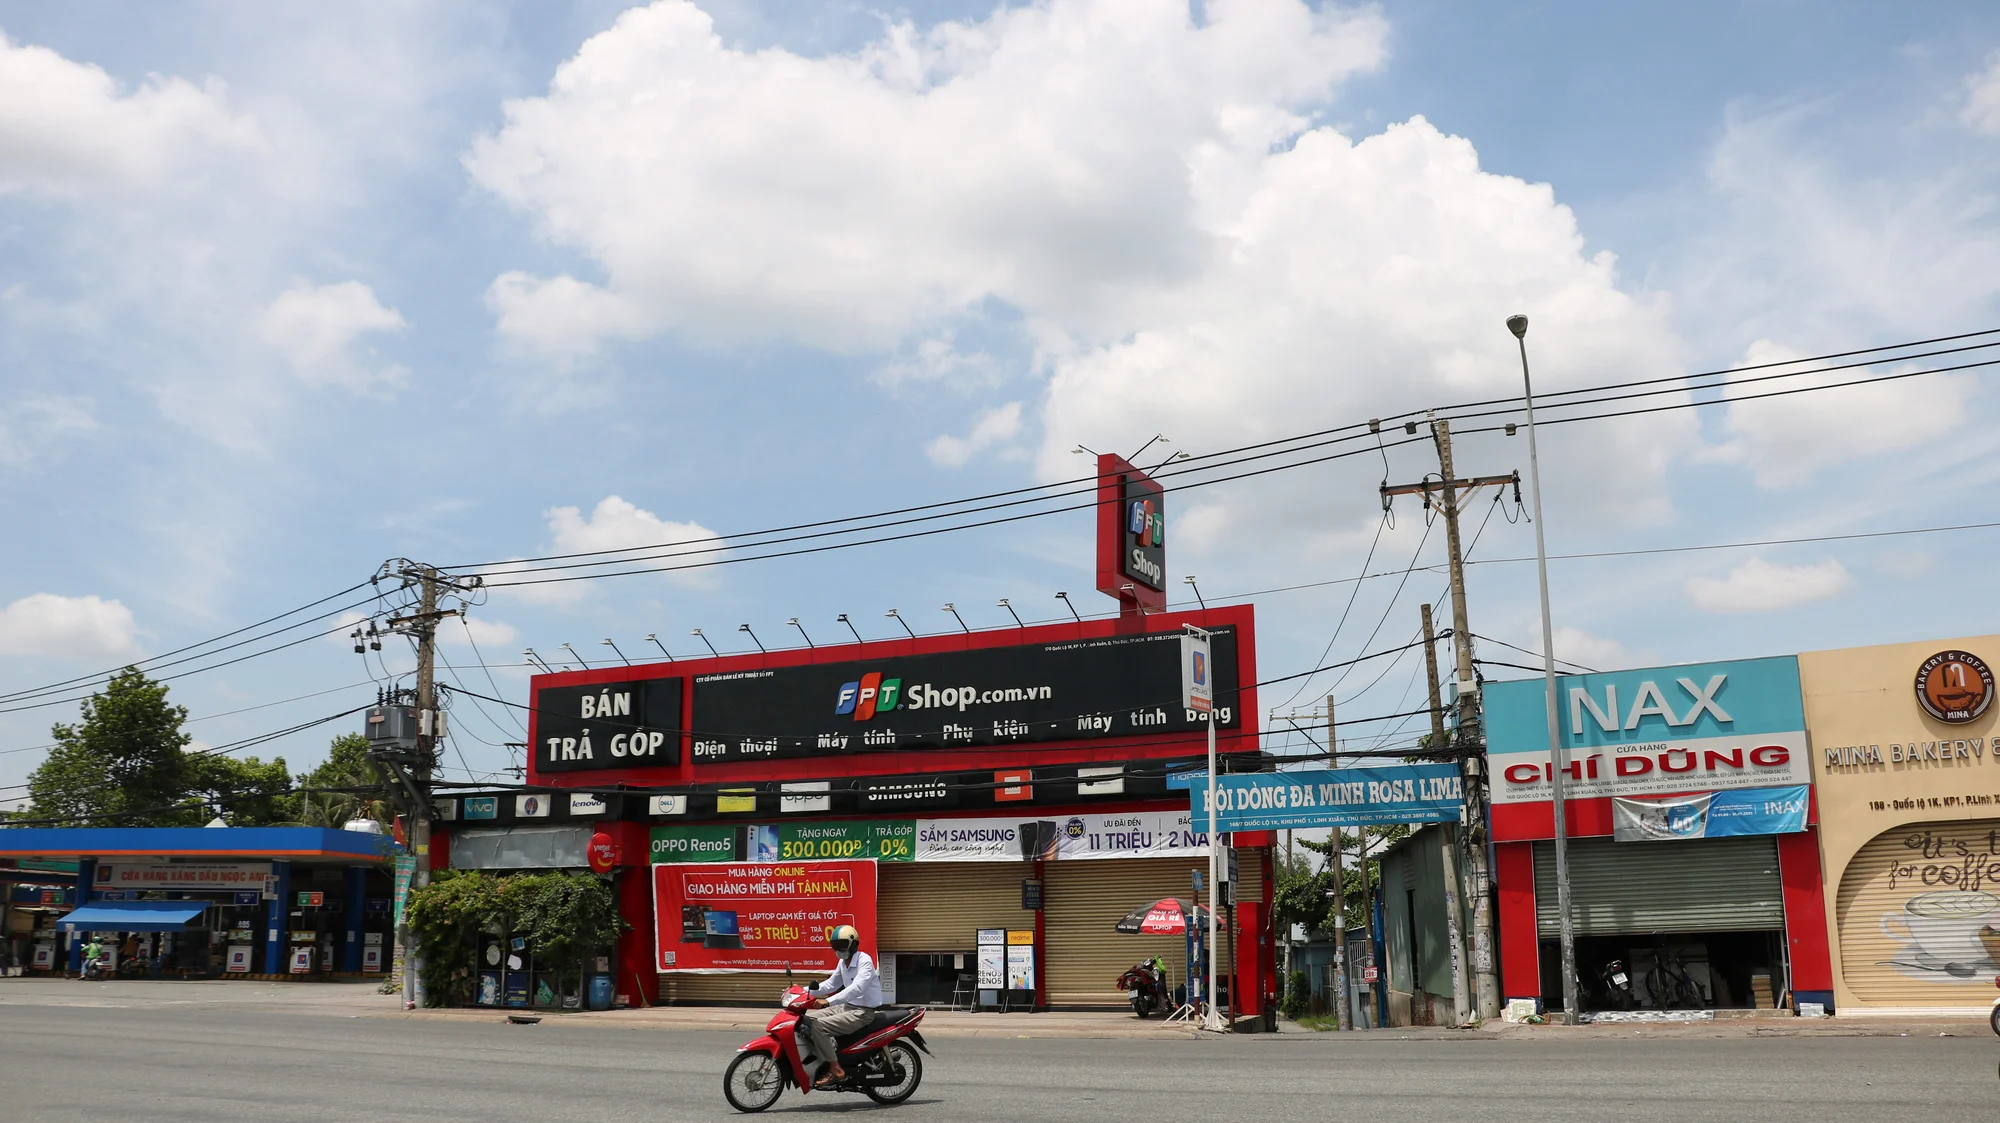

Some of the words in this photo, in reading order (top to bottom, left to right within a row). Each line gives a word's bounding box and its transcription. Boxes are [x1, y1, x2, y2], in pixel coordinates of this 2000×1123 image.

[1132, 549, 1161, 585] Shop
[1917, 655, 1943, 689] BAKERY
[1960, 654, 1992, 684] COFFEE
[581, 688, 631, 719] BÁN
[908, 683, 1052, 712] Shop.com.vn
[1545, 674, 1734, 736] NAX
[1947, 709, 1970, 720] MINA
[694, 740, 726, 759] Điện
[740, 737, 778, 756] thoại
[818, 731, 849, 750] Máy
[864, 728, 897, 746] tính
[943, 723, 974, 743] Phụ
[993, 720, 1029, 740] kiện
[1077, 712, 1113, 733] Máy
[1130, 708, 1167, 726] tính
[547, 728, 594, 762] TRẢ
[610, 726, 665, 757] GÓP
[1616, 744, 1637, 754] CỬA
[1639, 742, 1667, 752] HÀNG
[1825, 744, 1885, 768] MINA
[1889, 737, 1984, 764] BAKERY
[1504, 753, 1604, 784] CHÍ
[1615, 745, 1790, 777] DŨNG
[868, 782, 947, 801] SAMSUNG
[1236, 782, 1287, 811] DÒNG
[1290, 784, 1316, 808] ĐA
[1319, 782, 1364, 806] MINH
[1368, 779, 1416, 804] ROSA
[1419, 776, 1463, 801] LIMA
[1764, 800, 1805, 815] INAX
[1892, 797, 1914, 810] Quốc
[1927, 797, 1941, 808] 1K,
[1944, 796, 1963, 807] KP1,
[1104, 818, 1111, 828] ƯU
[1114, 818, 1126, 827] ĐÃI
[1128, 817, 1141, 826] ĐẾN
[1294, 816, 1306, 824] PHỐ
[797, 828, 821, 839] TẶNG
[822, 828, 847, 837] NGAY
[876, 824, 892, 836] TRẢ
[894, 824, 913, 836] GÓP
[920, 824, 947, 842] SẮM
[950, 829, 1016, 842] SAMSUNG
[1068, 826, 1082, 835] 0%
[652, 839, 687, 852] OPPO
[690, 838, 731, 851] Reno5
[880, 838, 908, 856] 0%
[965, 844, 982, 855] công
[1088, 833, 1100, 850] 11
[1105, 828, 1152, 854] TRIỆU
[1168, 831, 1178, 848] 2
[728, 868, 747, 877] MUA
[748, 866, 772, 877] HÀNG
[774, 867, 805, 877] ONLINE
[1888, 860, 1918, 890] for
[688, 884, 714, 895] GIAO
[716, 881, 748, 894] HÀNG
[750, 878, 775, 894] MIỄN
[778, 880, 795, 894] PHÍ
[797, 880, 820, 897] TẬN
[823, 878, 848, 893] NHÀ
[776, 912, 793, 920] CAM
[794, 909, 806, 920] KẾT
[808, 910, 821, 920] GIÁ
[822, 909, 838, 919] TỐT
[1168, 912, 1180, 921] RẺ
[754, 927, 761, 940] 3
[764, 924, 799, 944] TRIỆU
